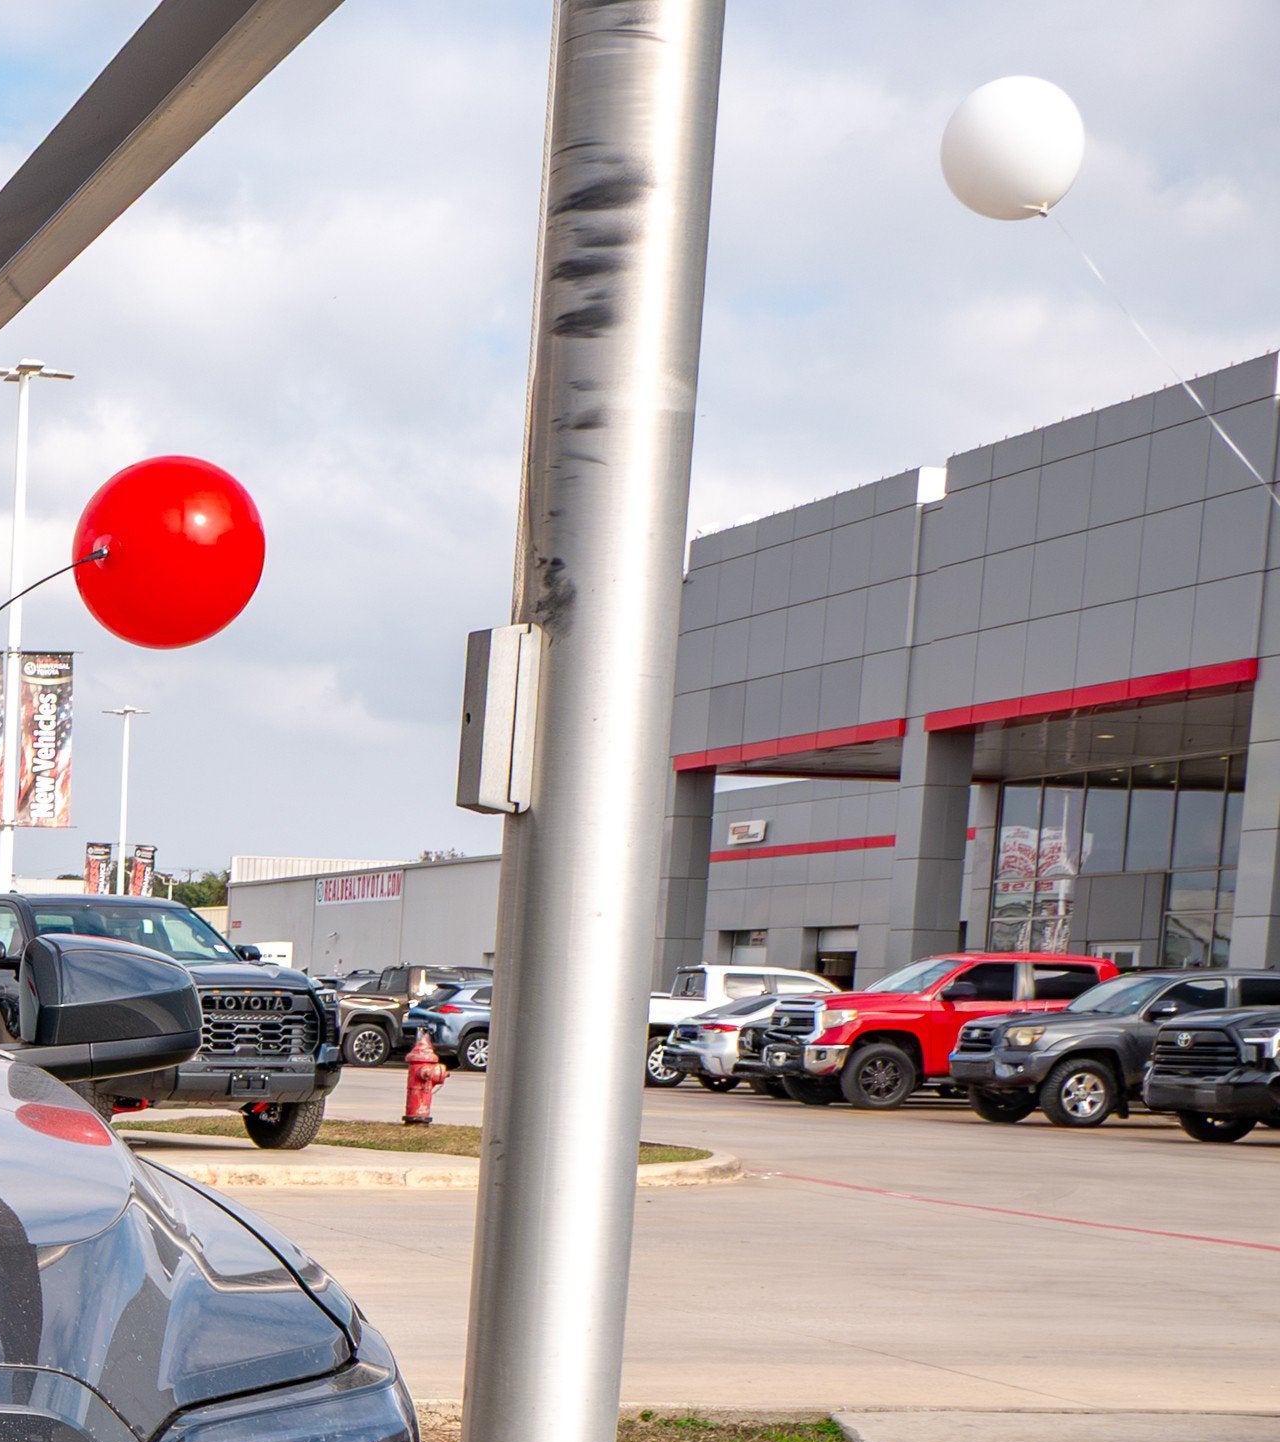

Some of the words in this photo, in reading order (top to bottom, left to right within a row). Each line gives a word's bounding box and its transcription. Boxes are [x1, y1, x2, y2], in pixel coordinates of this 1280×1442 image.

[32, 692, 57, 773] Vehicles
[30, 775, 55, 818] New
[323, 873, 402, 902] REALDEALTOYOTA.COM
[212, 996, 285, 1010] TOYOTA
